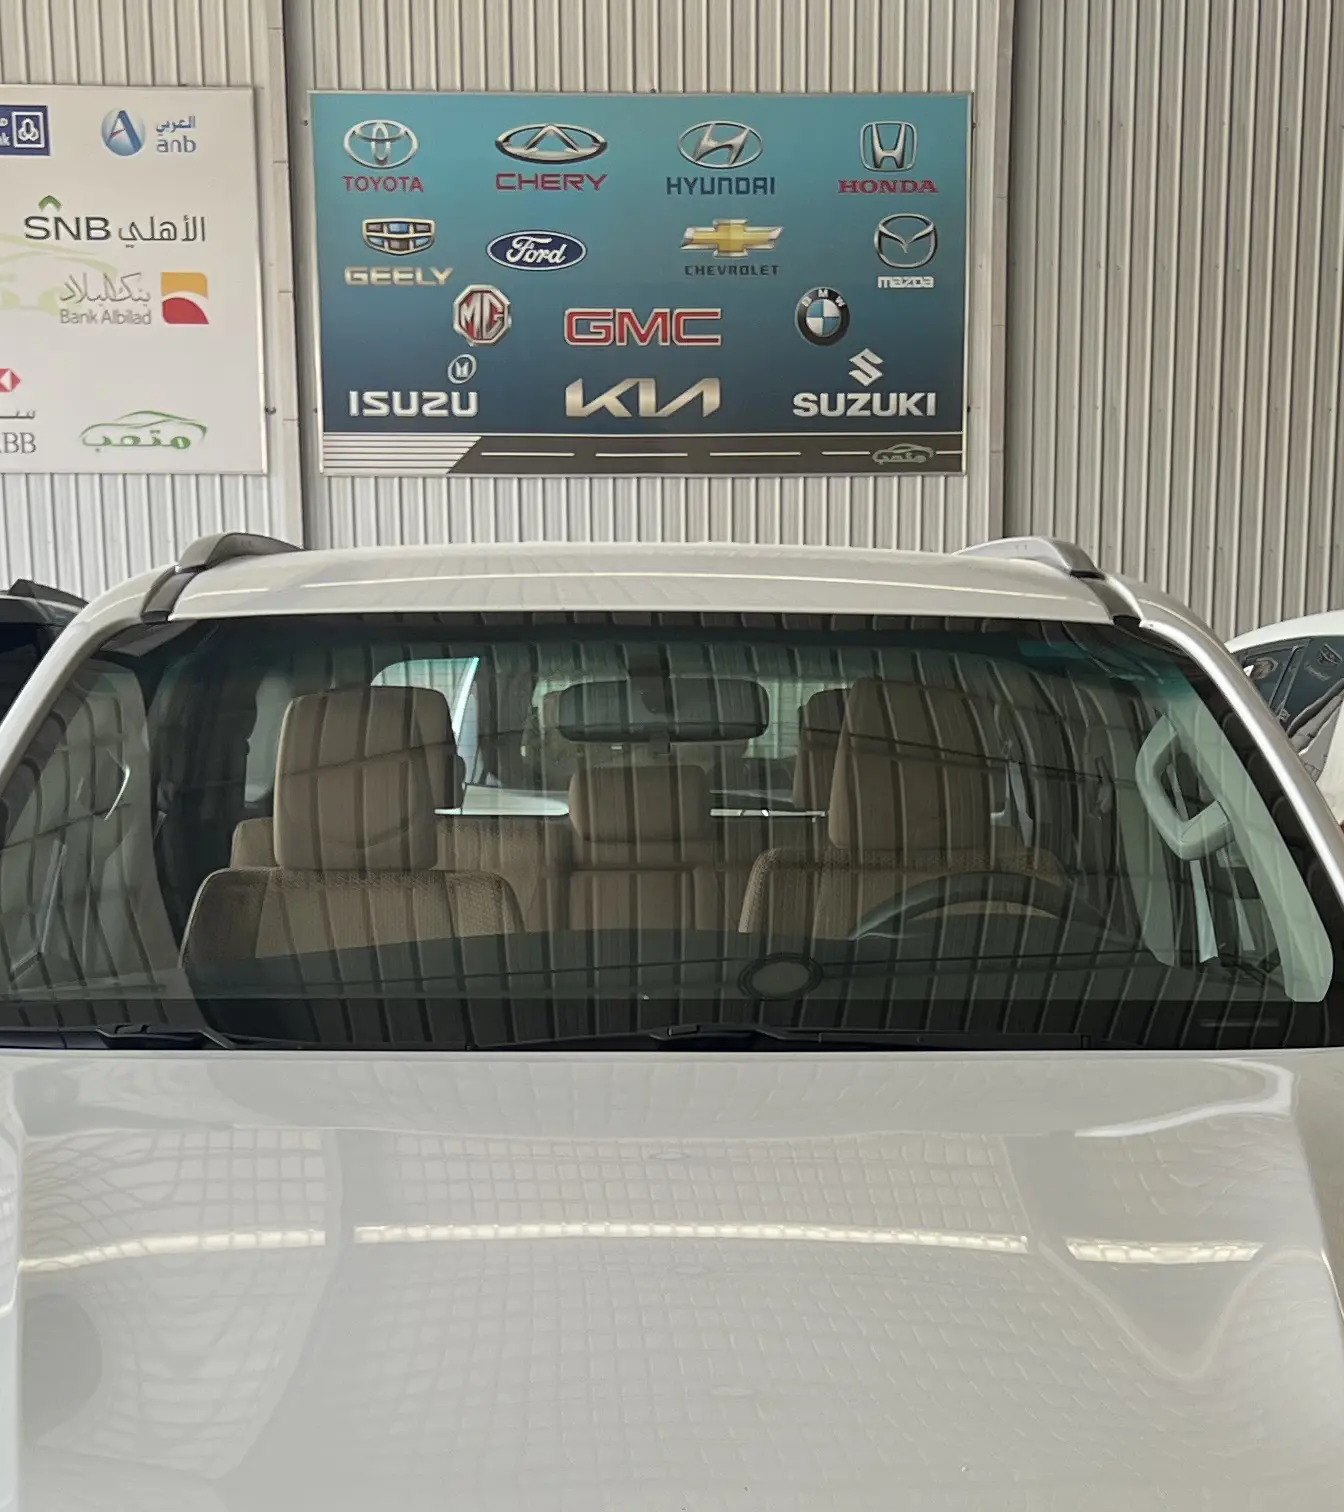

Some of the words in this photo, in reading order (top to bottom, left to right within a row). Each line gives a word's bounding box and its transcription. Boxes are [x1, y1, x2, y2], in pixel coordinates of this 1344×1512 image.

[155, 115, 196, 136] العربي
[157, 136, 197, 153] anb
[342, 174, 424, 193] TOYOTA
[494, 172, 607, 191] CHERY
[666, 177, 776, 195] HYUNDAI
[838, 179, 940, 194] HONDA
[23, 215, 112, 241] SNB
[118, 214, 206, 249] الأهلي
[505, 234, 568, 265] Ford
[344, 266, 454, 286] GEELY
[684, 264, 780, 276] CHEVROLET
[877, 276, 935, 289] mazda
[59, 308, 97, 324] Bank
[101, 308, 152, 325] Albilad
[459, 291, 504, 340] MG
[564, 308, 722, 346] GMC
[349, 390, 478, 418] ISUZU
[565, 377, 721, 418] KIA
[792, 392, 937, 417] SUZUKI
